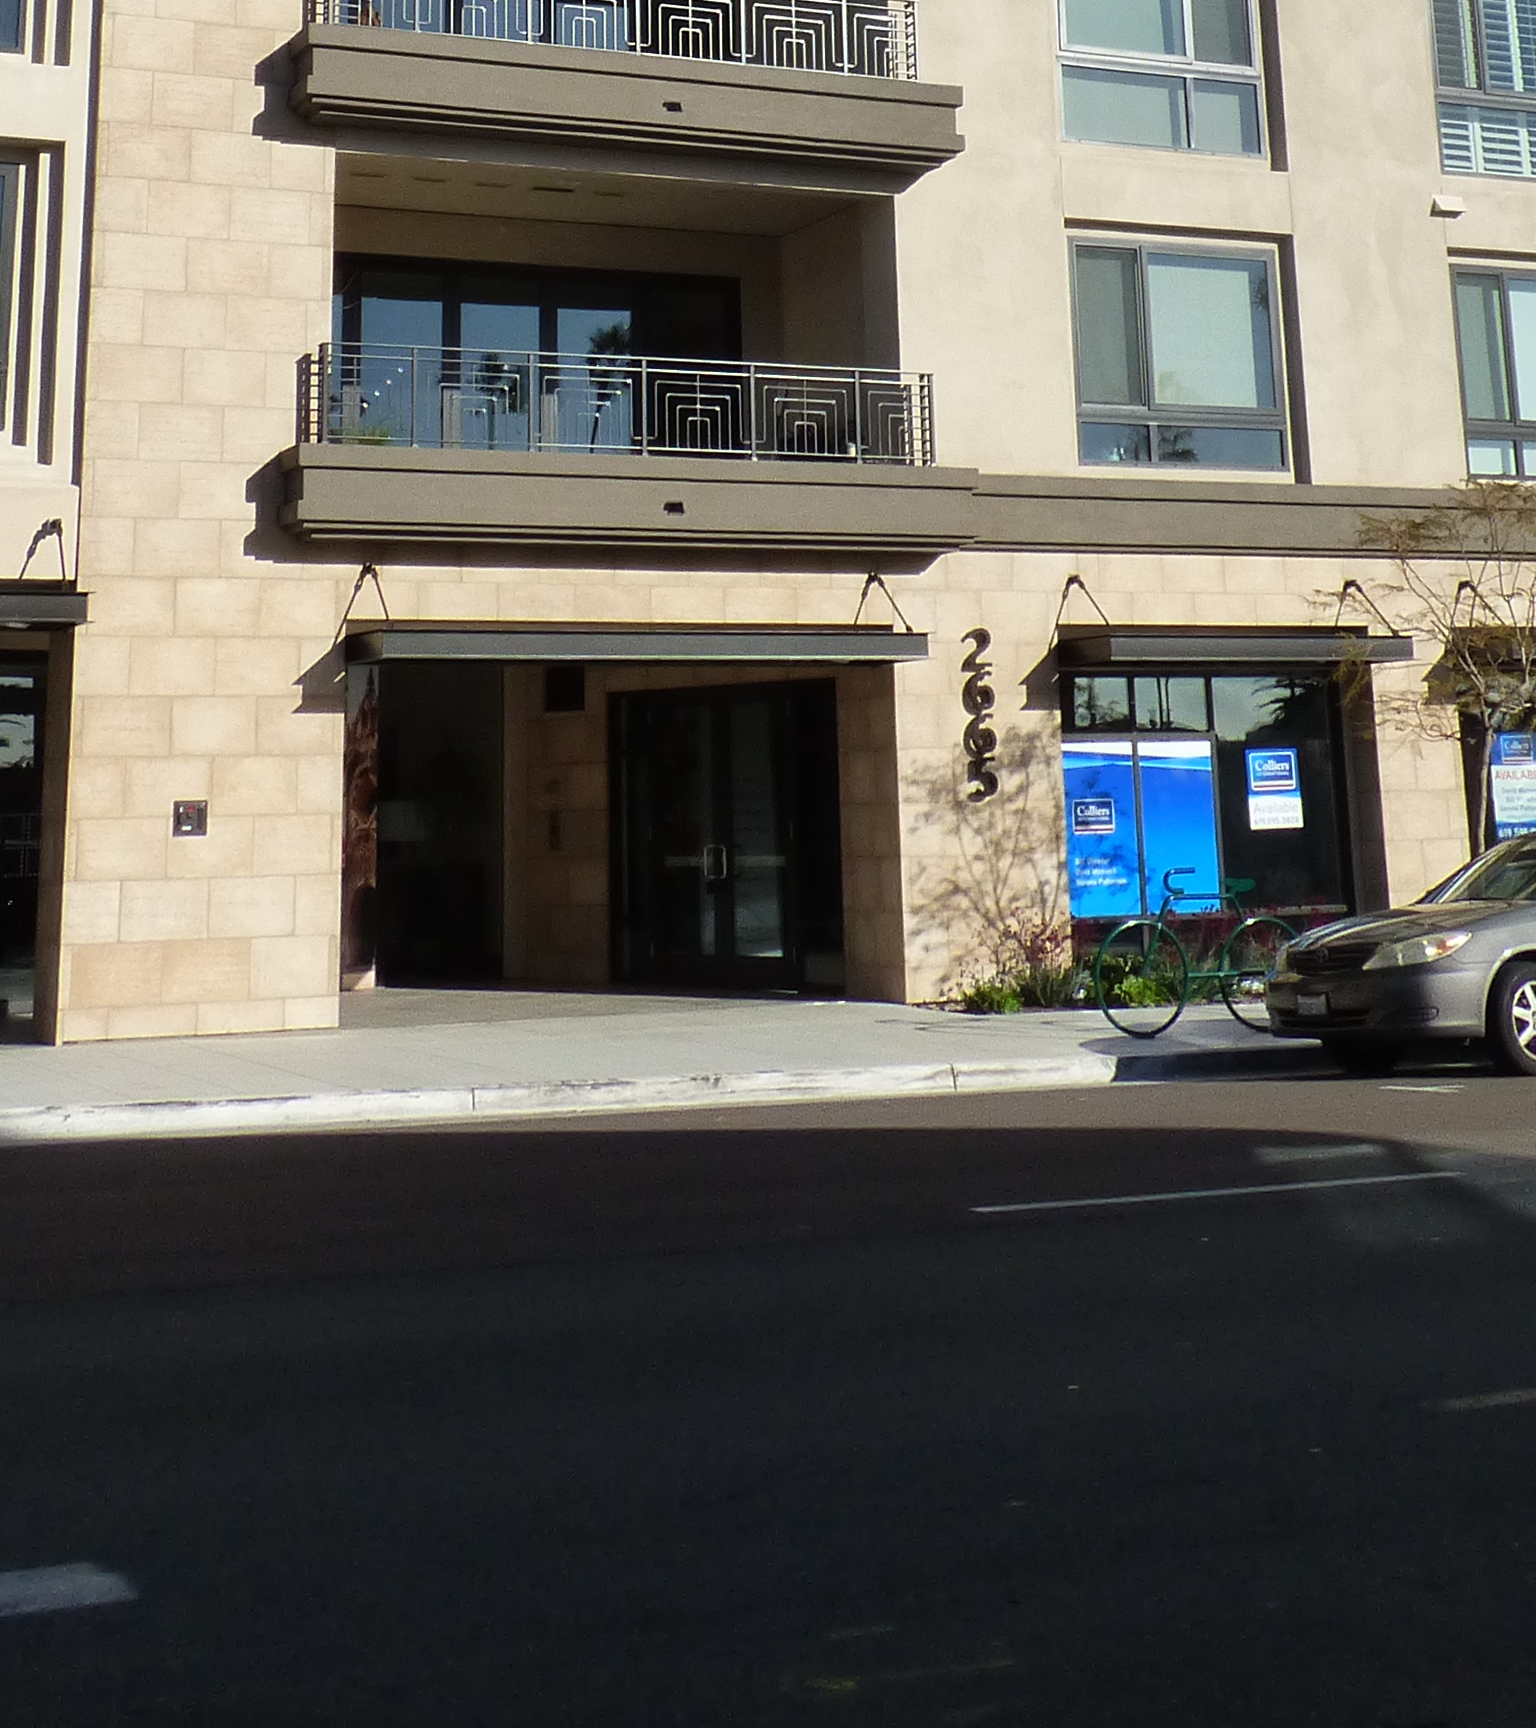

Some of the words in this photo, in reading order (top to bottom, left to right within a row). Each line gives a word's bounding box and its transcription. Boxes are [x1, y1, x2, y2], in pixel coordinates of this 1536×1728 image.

[960, 627, 999, 803] 2665
[1254, 759, 1290, 771] Colliers
[1076, 805, 1110, 816] Colliers
